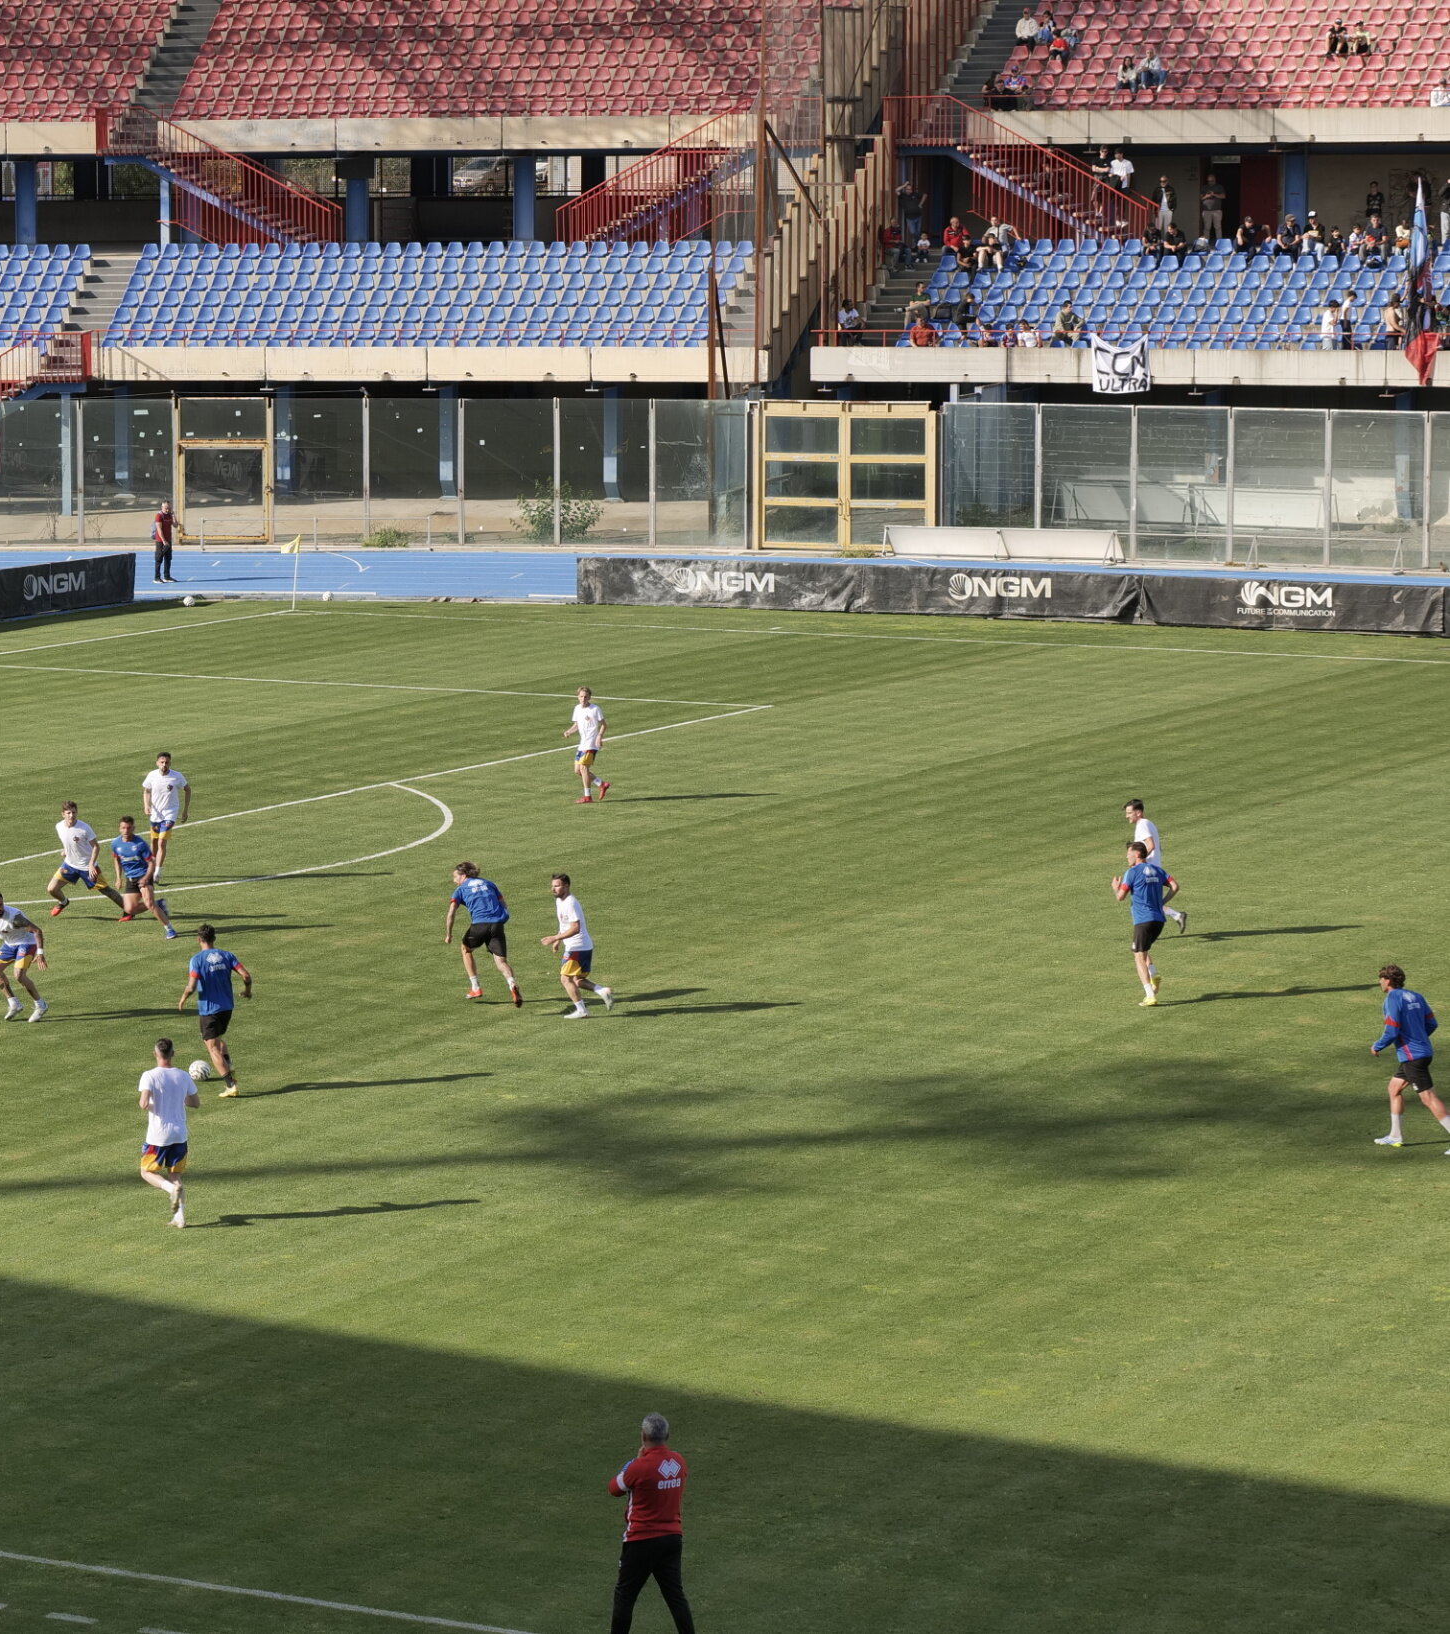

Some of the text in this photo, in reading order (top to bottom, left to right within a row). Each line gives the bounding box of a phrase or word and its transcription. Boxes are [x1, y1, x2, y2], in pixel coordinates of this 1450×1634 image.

[37, 571, 86, 596] NGM
[695, 571, 775, 593] NGM
[971, 576, 1052, 599] NGM
[1241, 581, 1333, 608] NGM
[1236, 607, 1266, 616] FUTURE
[1273, 608, 1336, 618] COMMUNICATION
